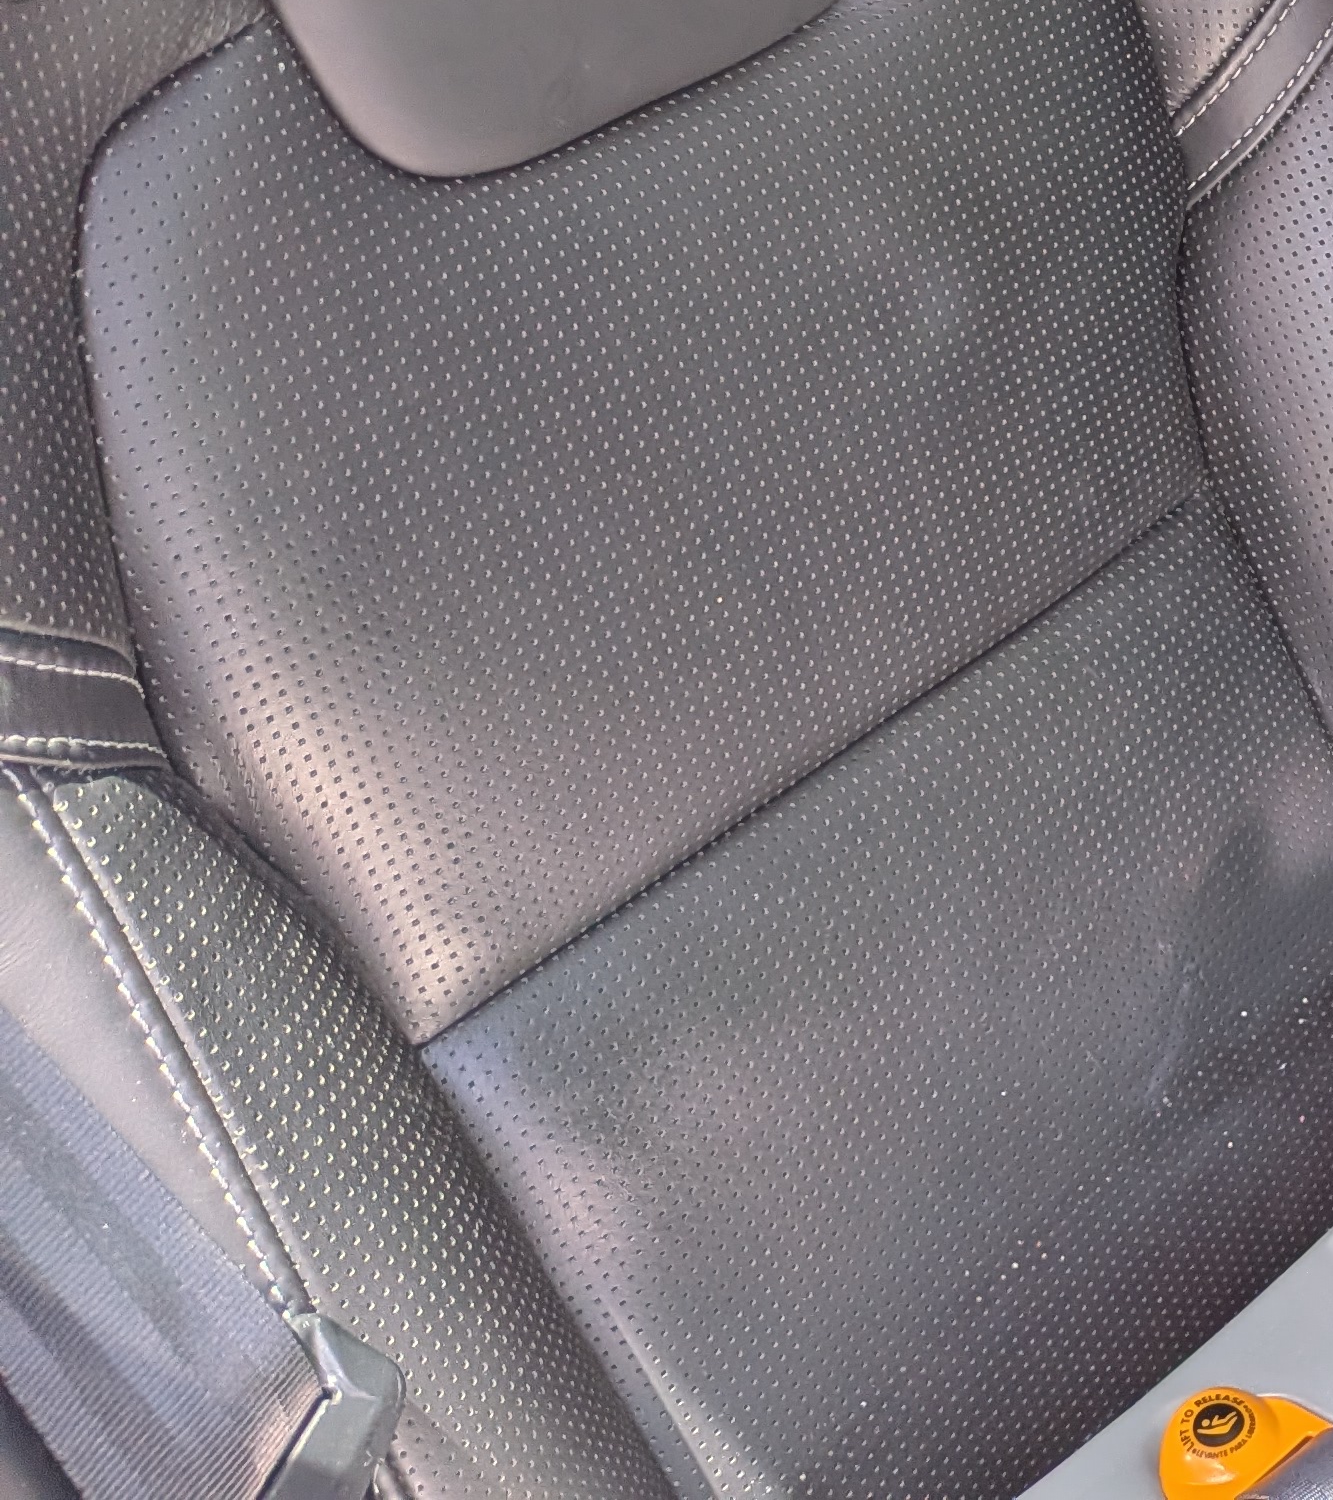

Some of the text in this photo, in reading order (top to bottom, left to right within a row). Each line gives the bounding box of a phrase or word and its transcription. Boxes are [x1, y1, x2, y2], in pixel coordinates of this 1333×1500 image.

[1180, 1393, 1244, 1451] LIFT TO RELEASE
